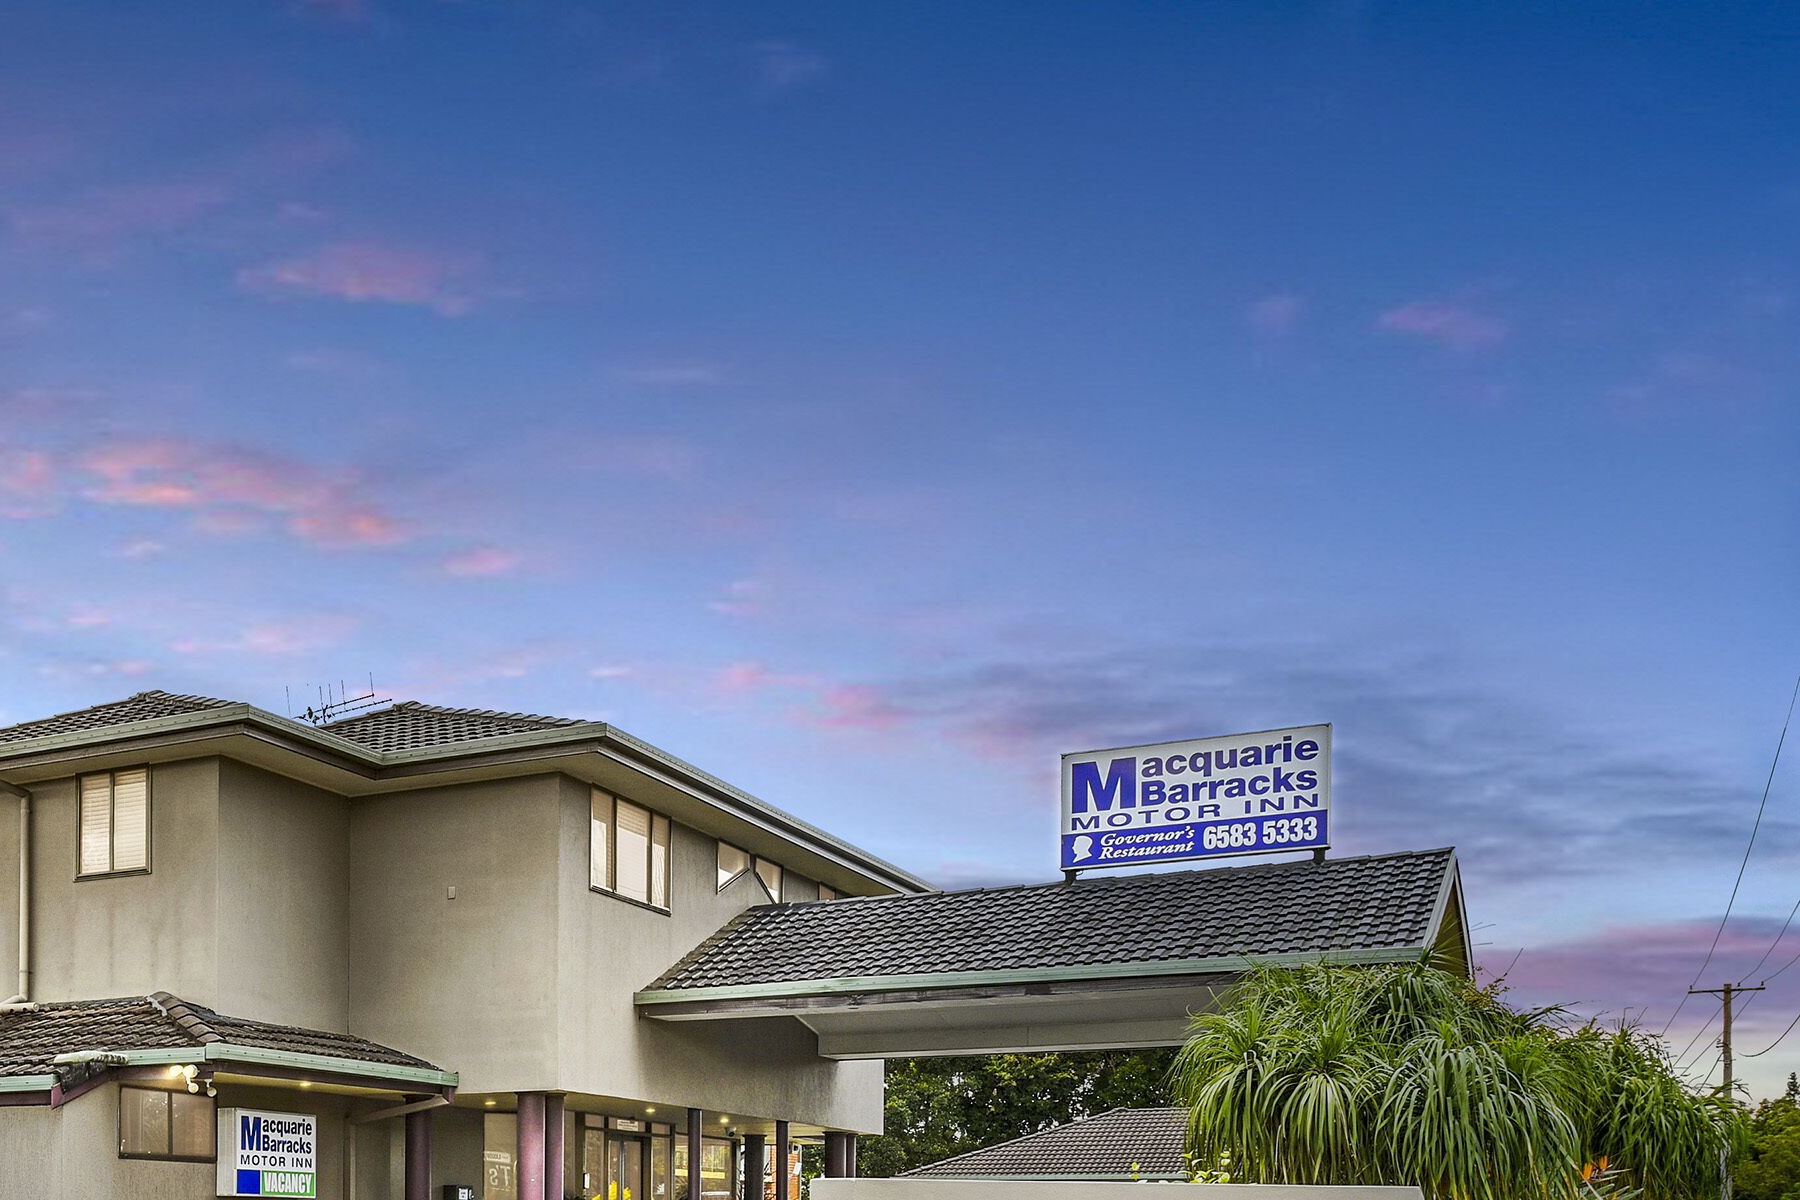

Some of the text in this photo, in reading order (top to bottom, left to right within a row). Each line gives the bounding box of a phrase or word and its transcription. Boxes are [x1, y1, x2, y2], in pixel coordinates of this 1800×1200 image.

[1141, 767, 1318, 807] Barracks
[1071, 793, 1318, 831] MOTOR INN
[1100, 816, 1318, 849] Governor's 6583 5333
[1098, 841, 1194, 860] Restaurant
[262, 1134, 312, 1154] Barracks
[240, 1154, 312, 1168] MOTOR INN
[264, 1172, 312, 1194] VACANCY
